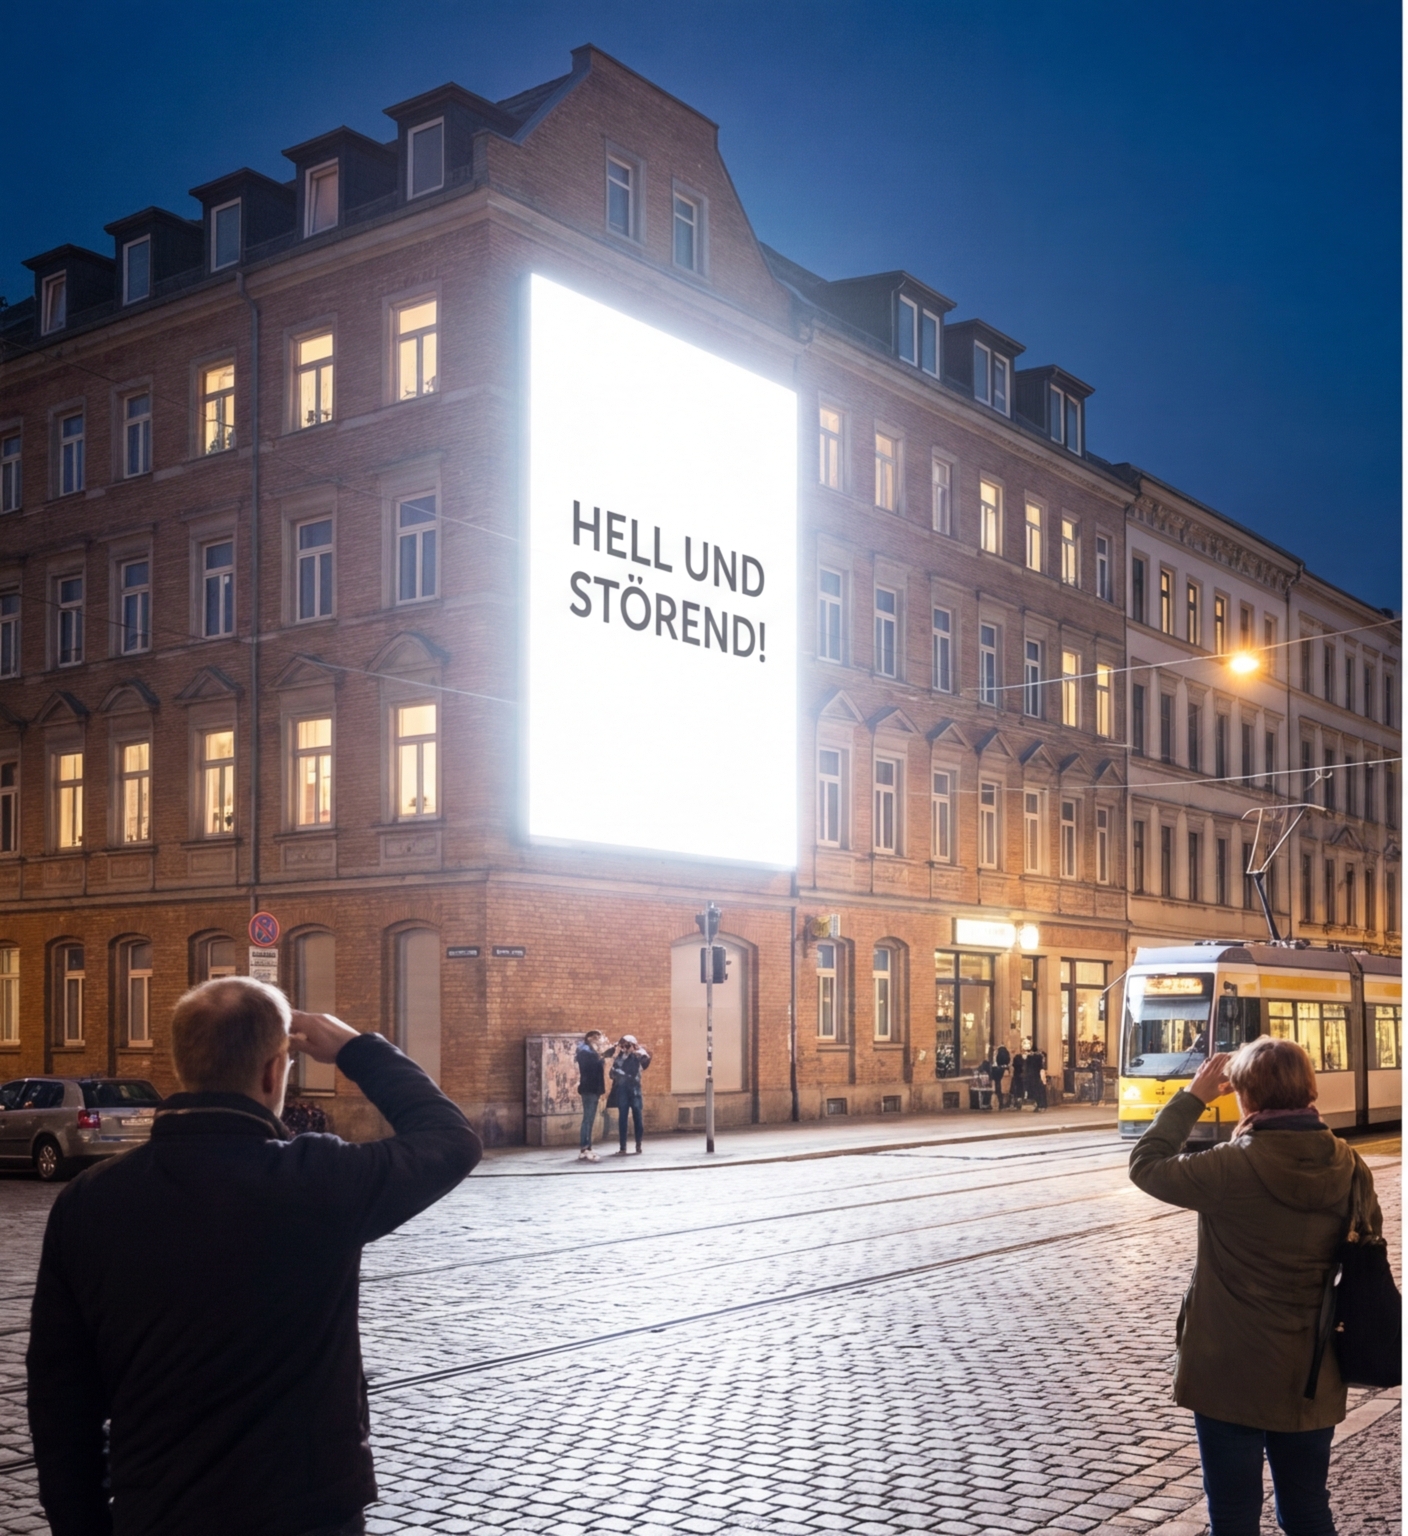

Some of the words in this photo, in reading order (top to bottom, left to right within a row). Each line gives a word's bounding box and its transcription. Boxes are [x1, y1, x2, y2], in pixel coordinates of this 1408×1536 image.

[573, 499, 673, 573] HELL
[685, 535, 765, 598] UND
[569, 570, 766, 663] STÖREND!
